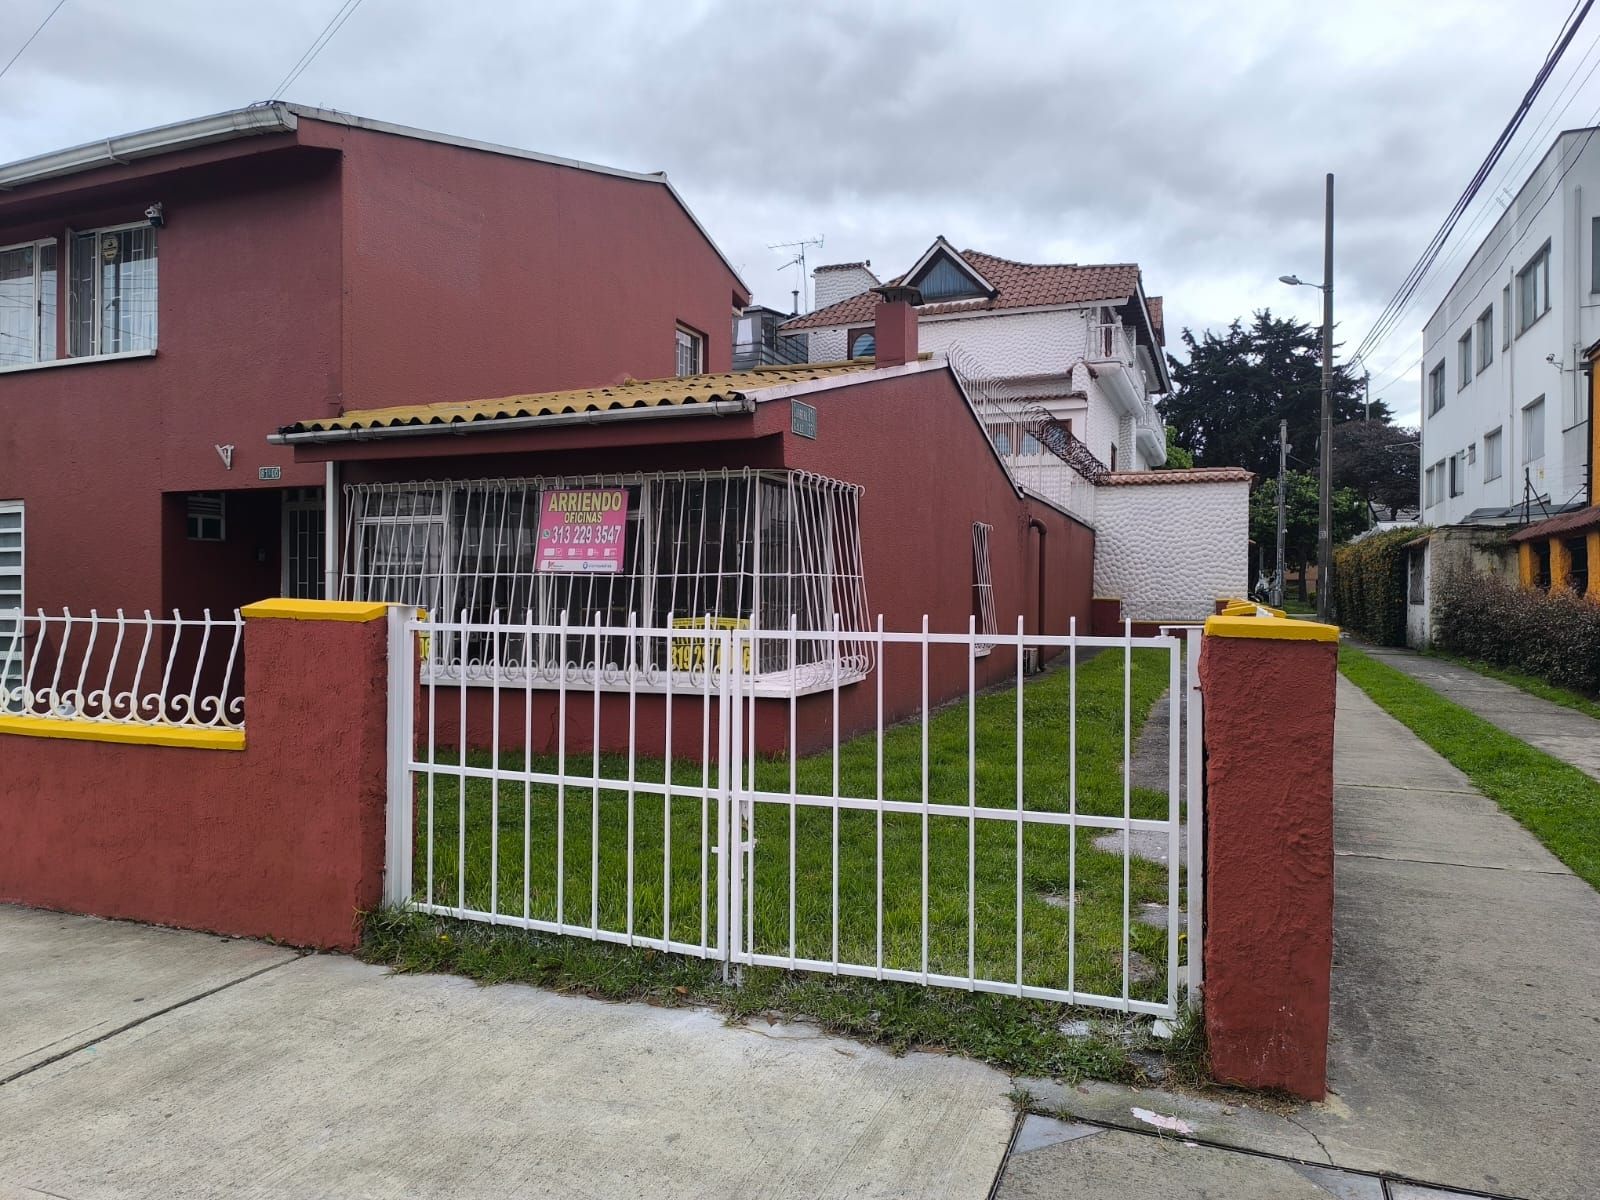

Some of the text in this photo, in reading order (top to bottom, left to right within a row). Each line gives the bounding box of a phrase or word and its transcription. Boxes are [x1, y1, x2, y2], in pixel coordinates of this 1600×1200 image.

[548, 491, 623, 512] ARRIENDO
[564, 511, 603, 524] OFICINAS
[551, 525, 621, 544] 313 229 3547
